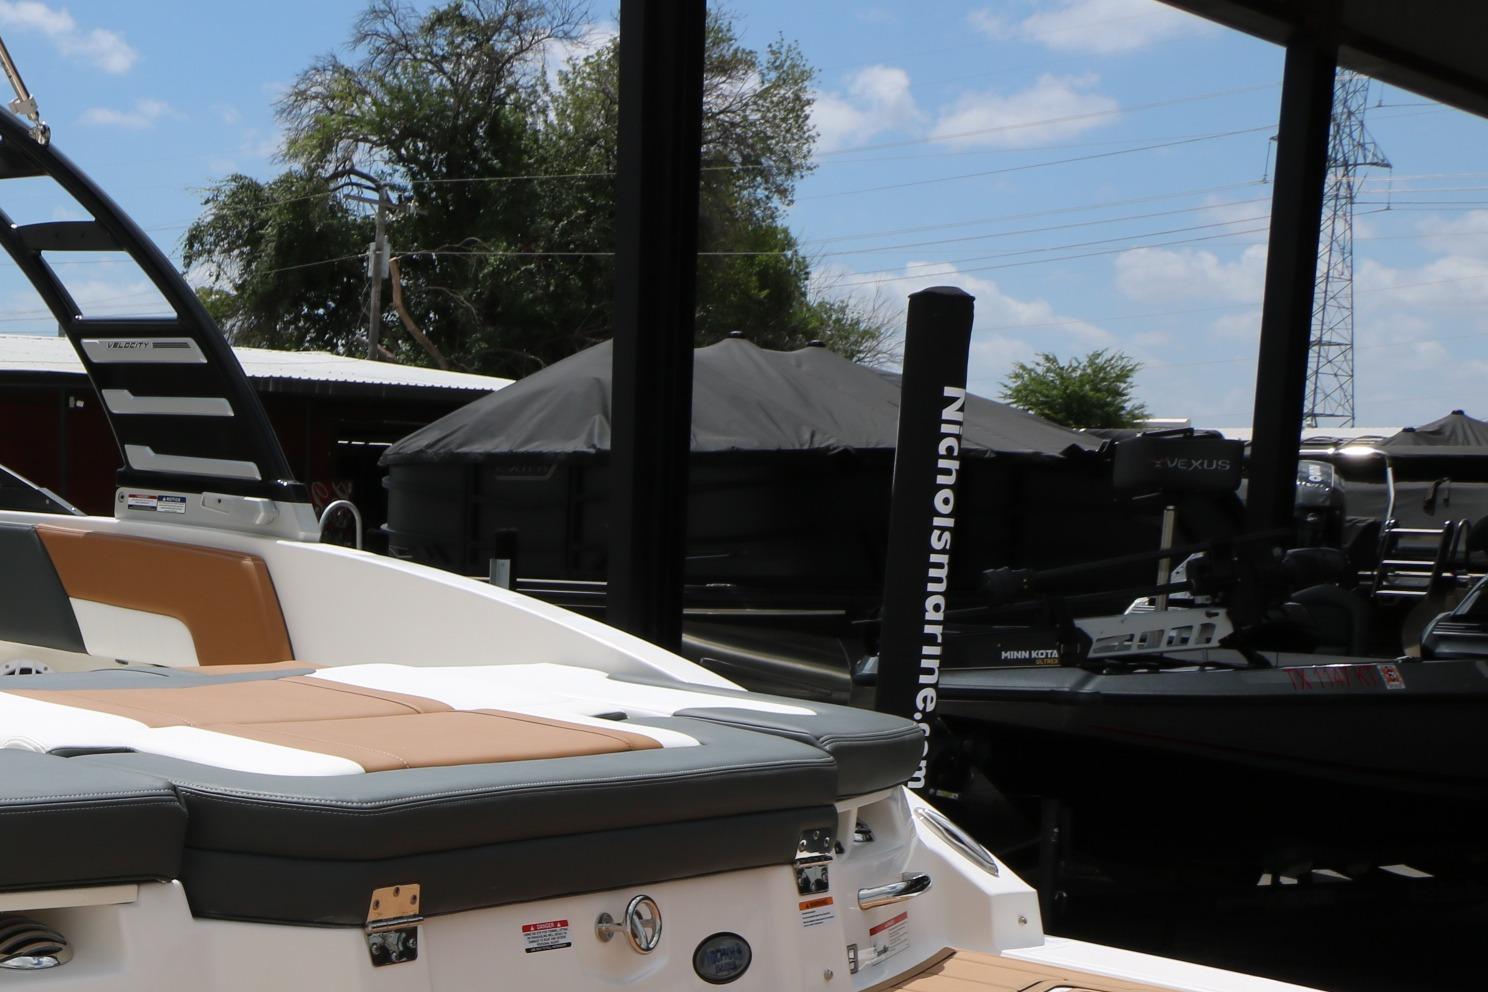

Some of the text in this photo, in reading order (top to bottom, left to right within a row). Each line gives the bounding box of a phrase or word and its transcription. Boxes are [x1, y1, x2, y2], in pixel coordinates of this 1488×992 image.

[1167, 457, 1231, 471] VEXUS
[1001, 649, 1059, 660] MINN KOTA
